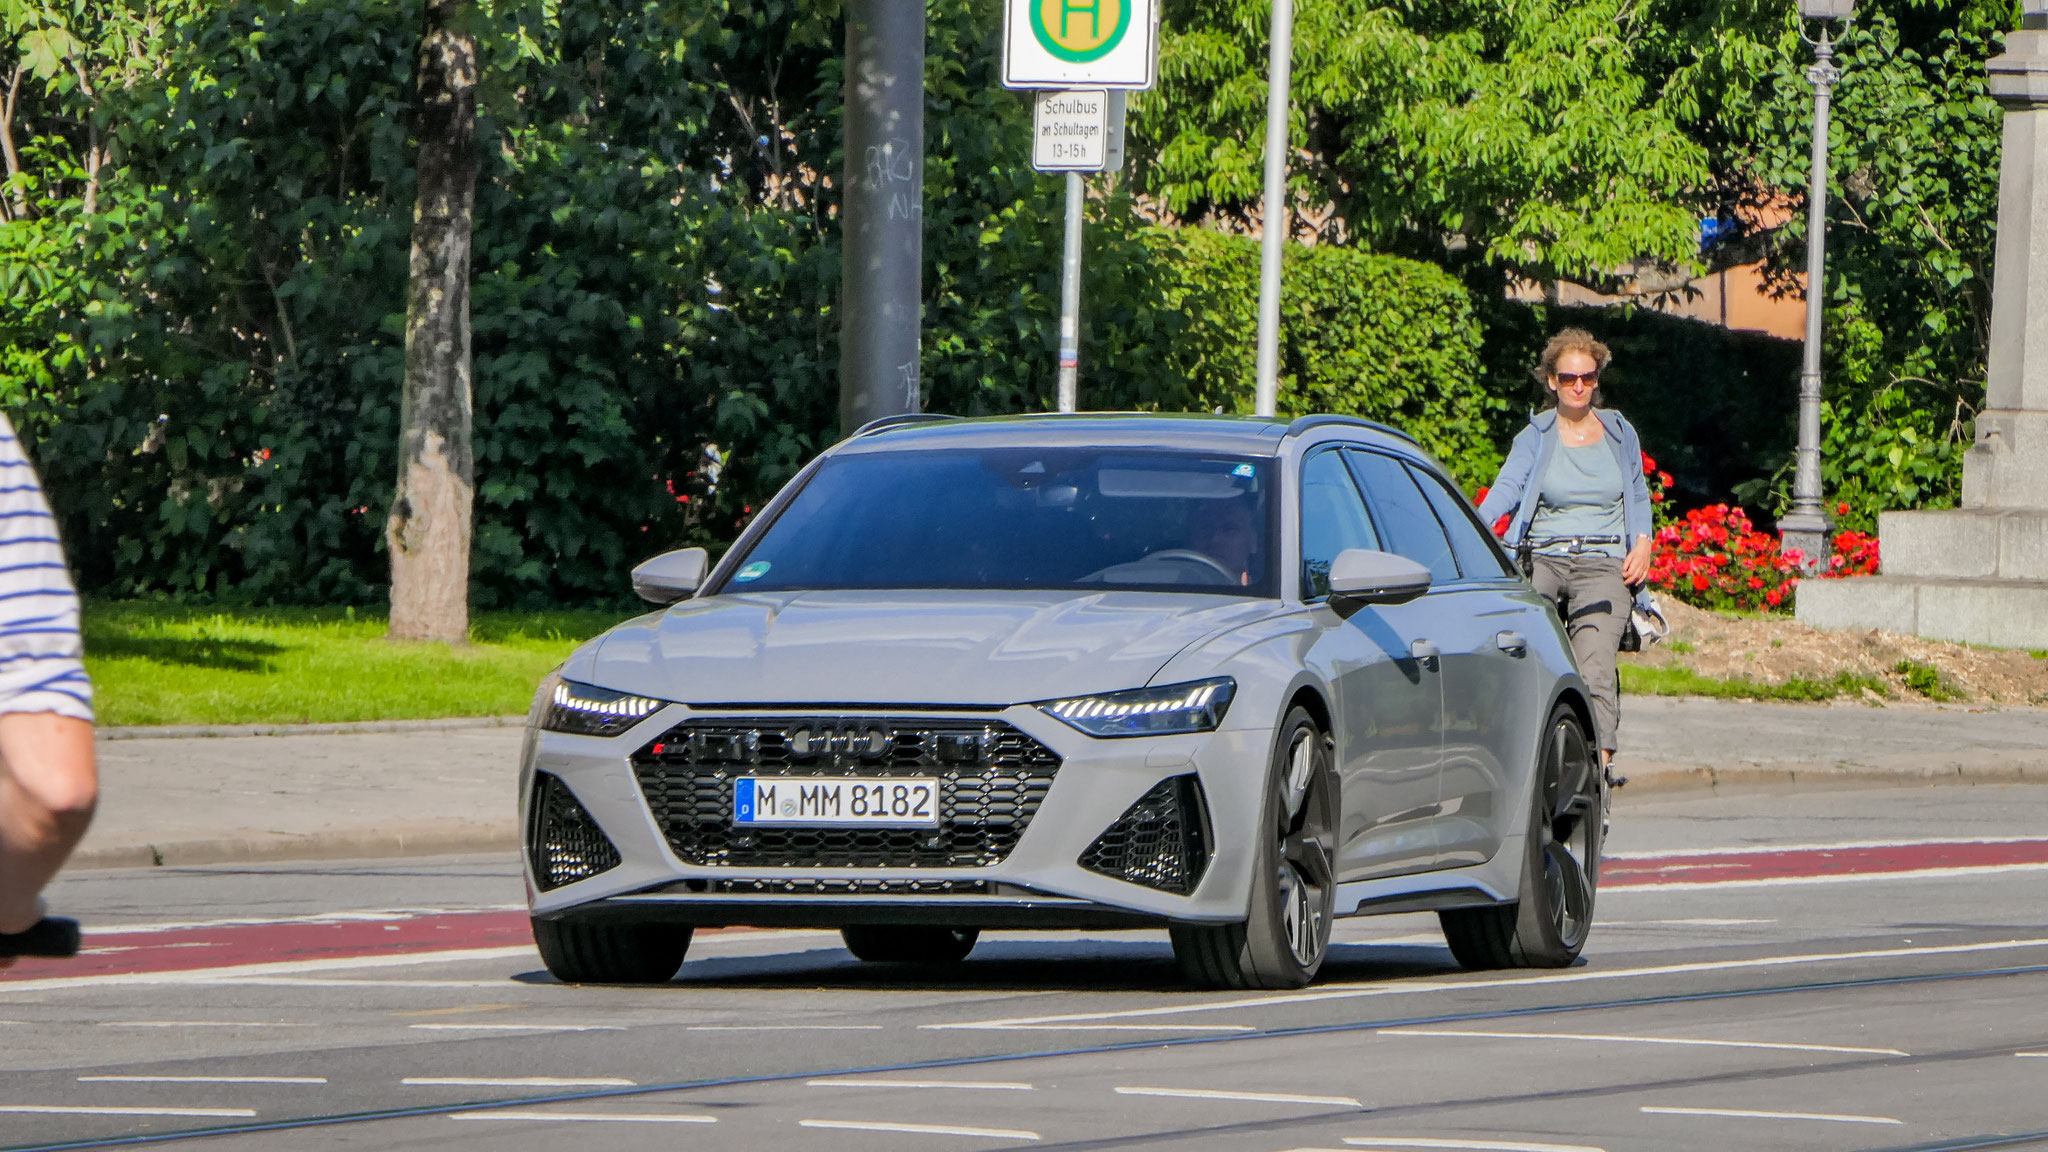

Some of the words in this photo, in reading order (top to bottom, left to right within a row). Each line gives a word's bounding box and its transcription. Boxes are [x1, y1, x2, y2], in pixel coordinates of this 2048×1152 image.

[1060, 0, 1100, 39] H
[1044, 99, 1098, 115] Schulbus
[1042, 125, 1051, 136] an
[1053, 122, 1099, 140] Schultagen
[741, 803, 750, 815] D
[757, 784, 776, 816] M
[799, 784, 841, 816] MM
[850, 784, 931, 817] 8182
